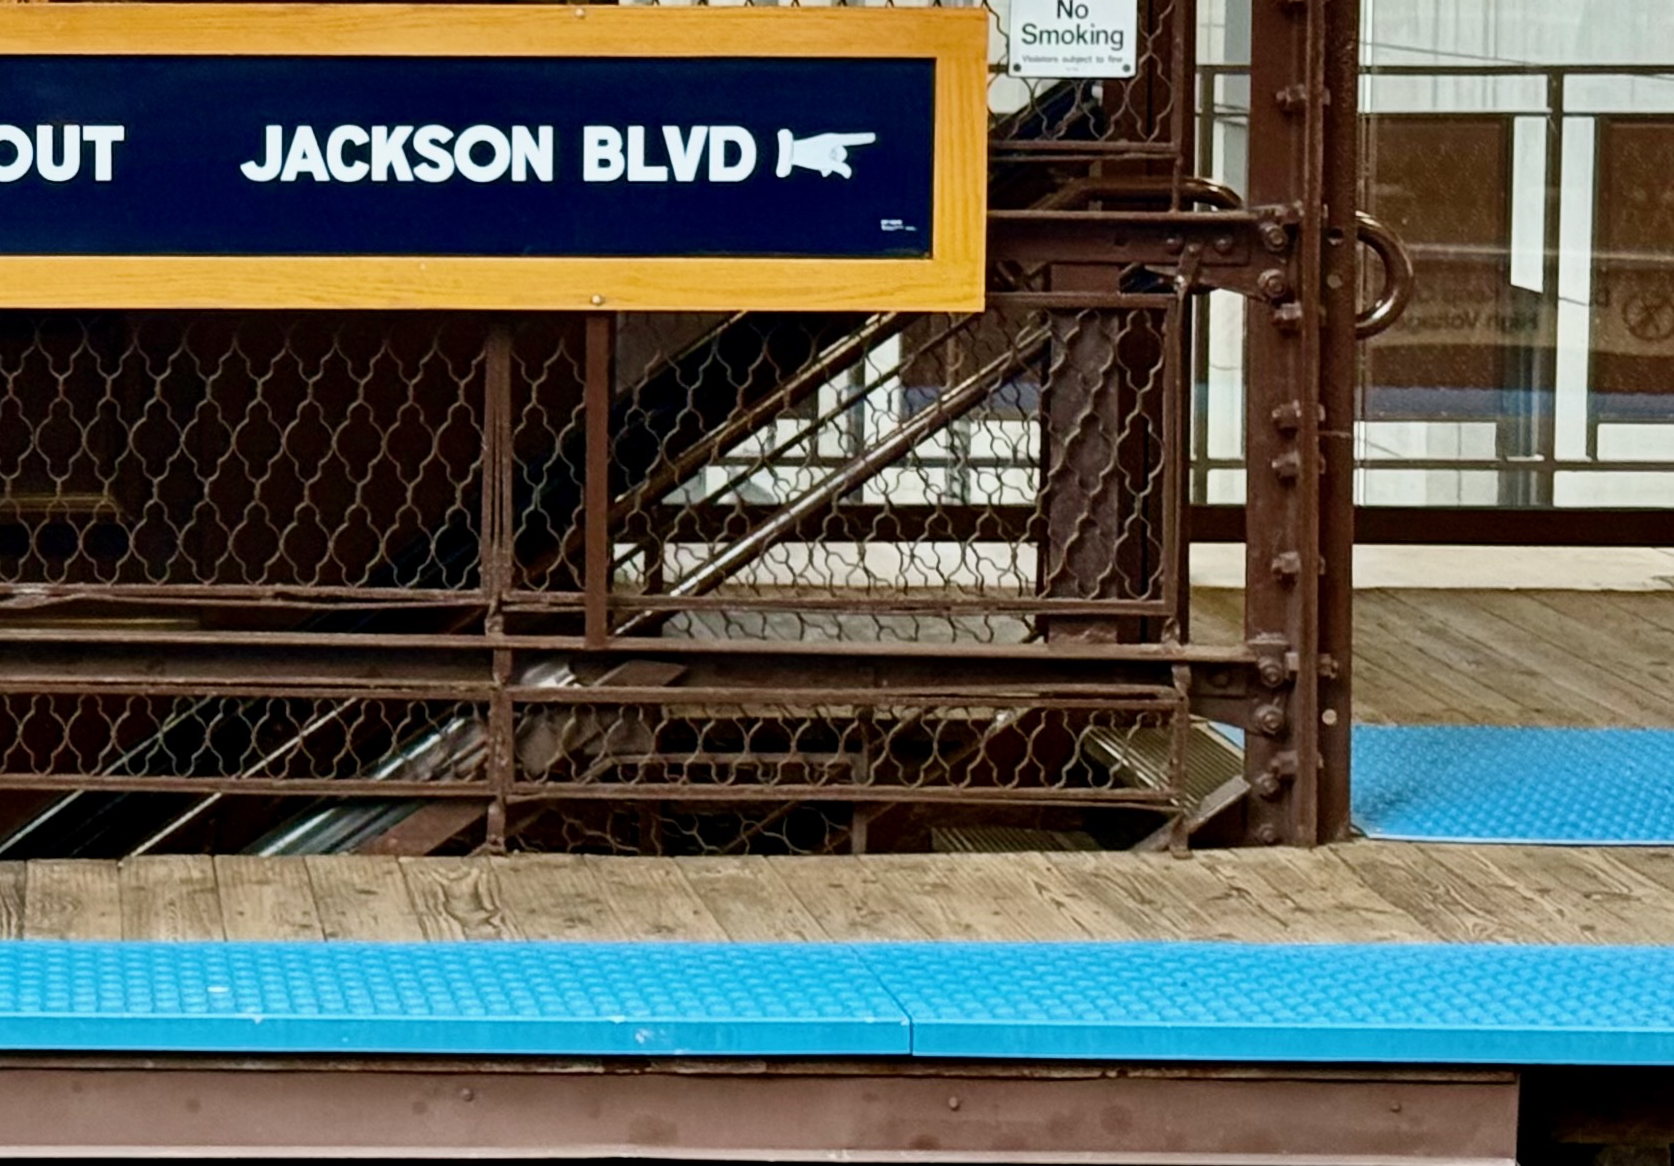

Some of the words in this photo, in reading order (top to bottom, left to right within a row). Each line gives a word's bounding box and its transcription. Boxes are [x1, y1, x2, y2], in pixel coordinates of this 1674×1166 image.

[1021, 23, 1124, 51] Smoking
[240, 124, 554, 183] JACKSON
[583, 125, 757, 182] BLVD
